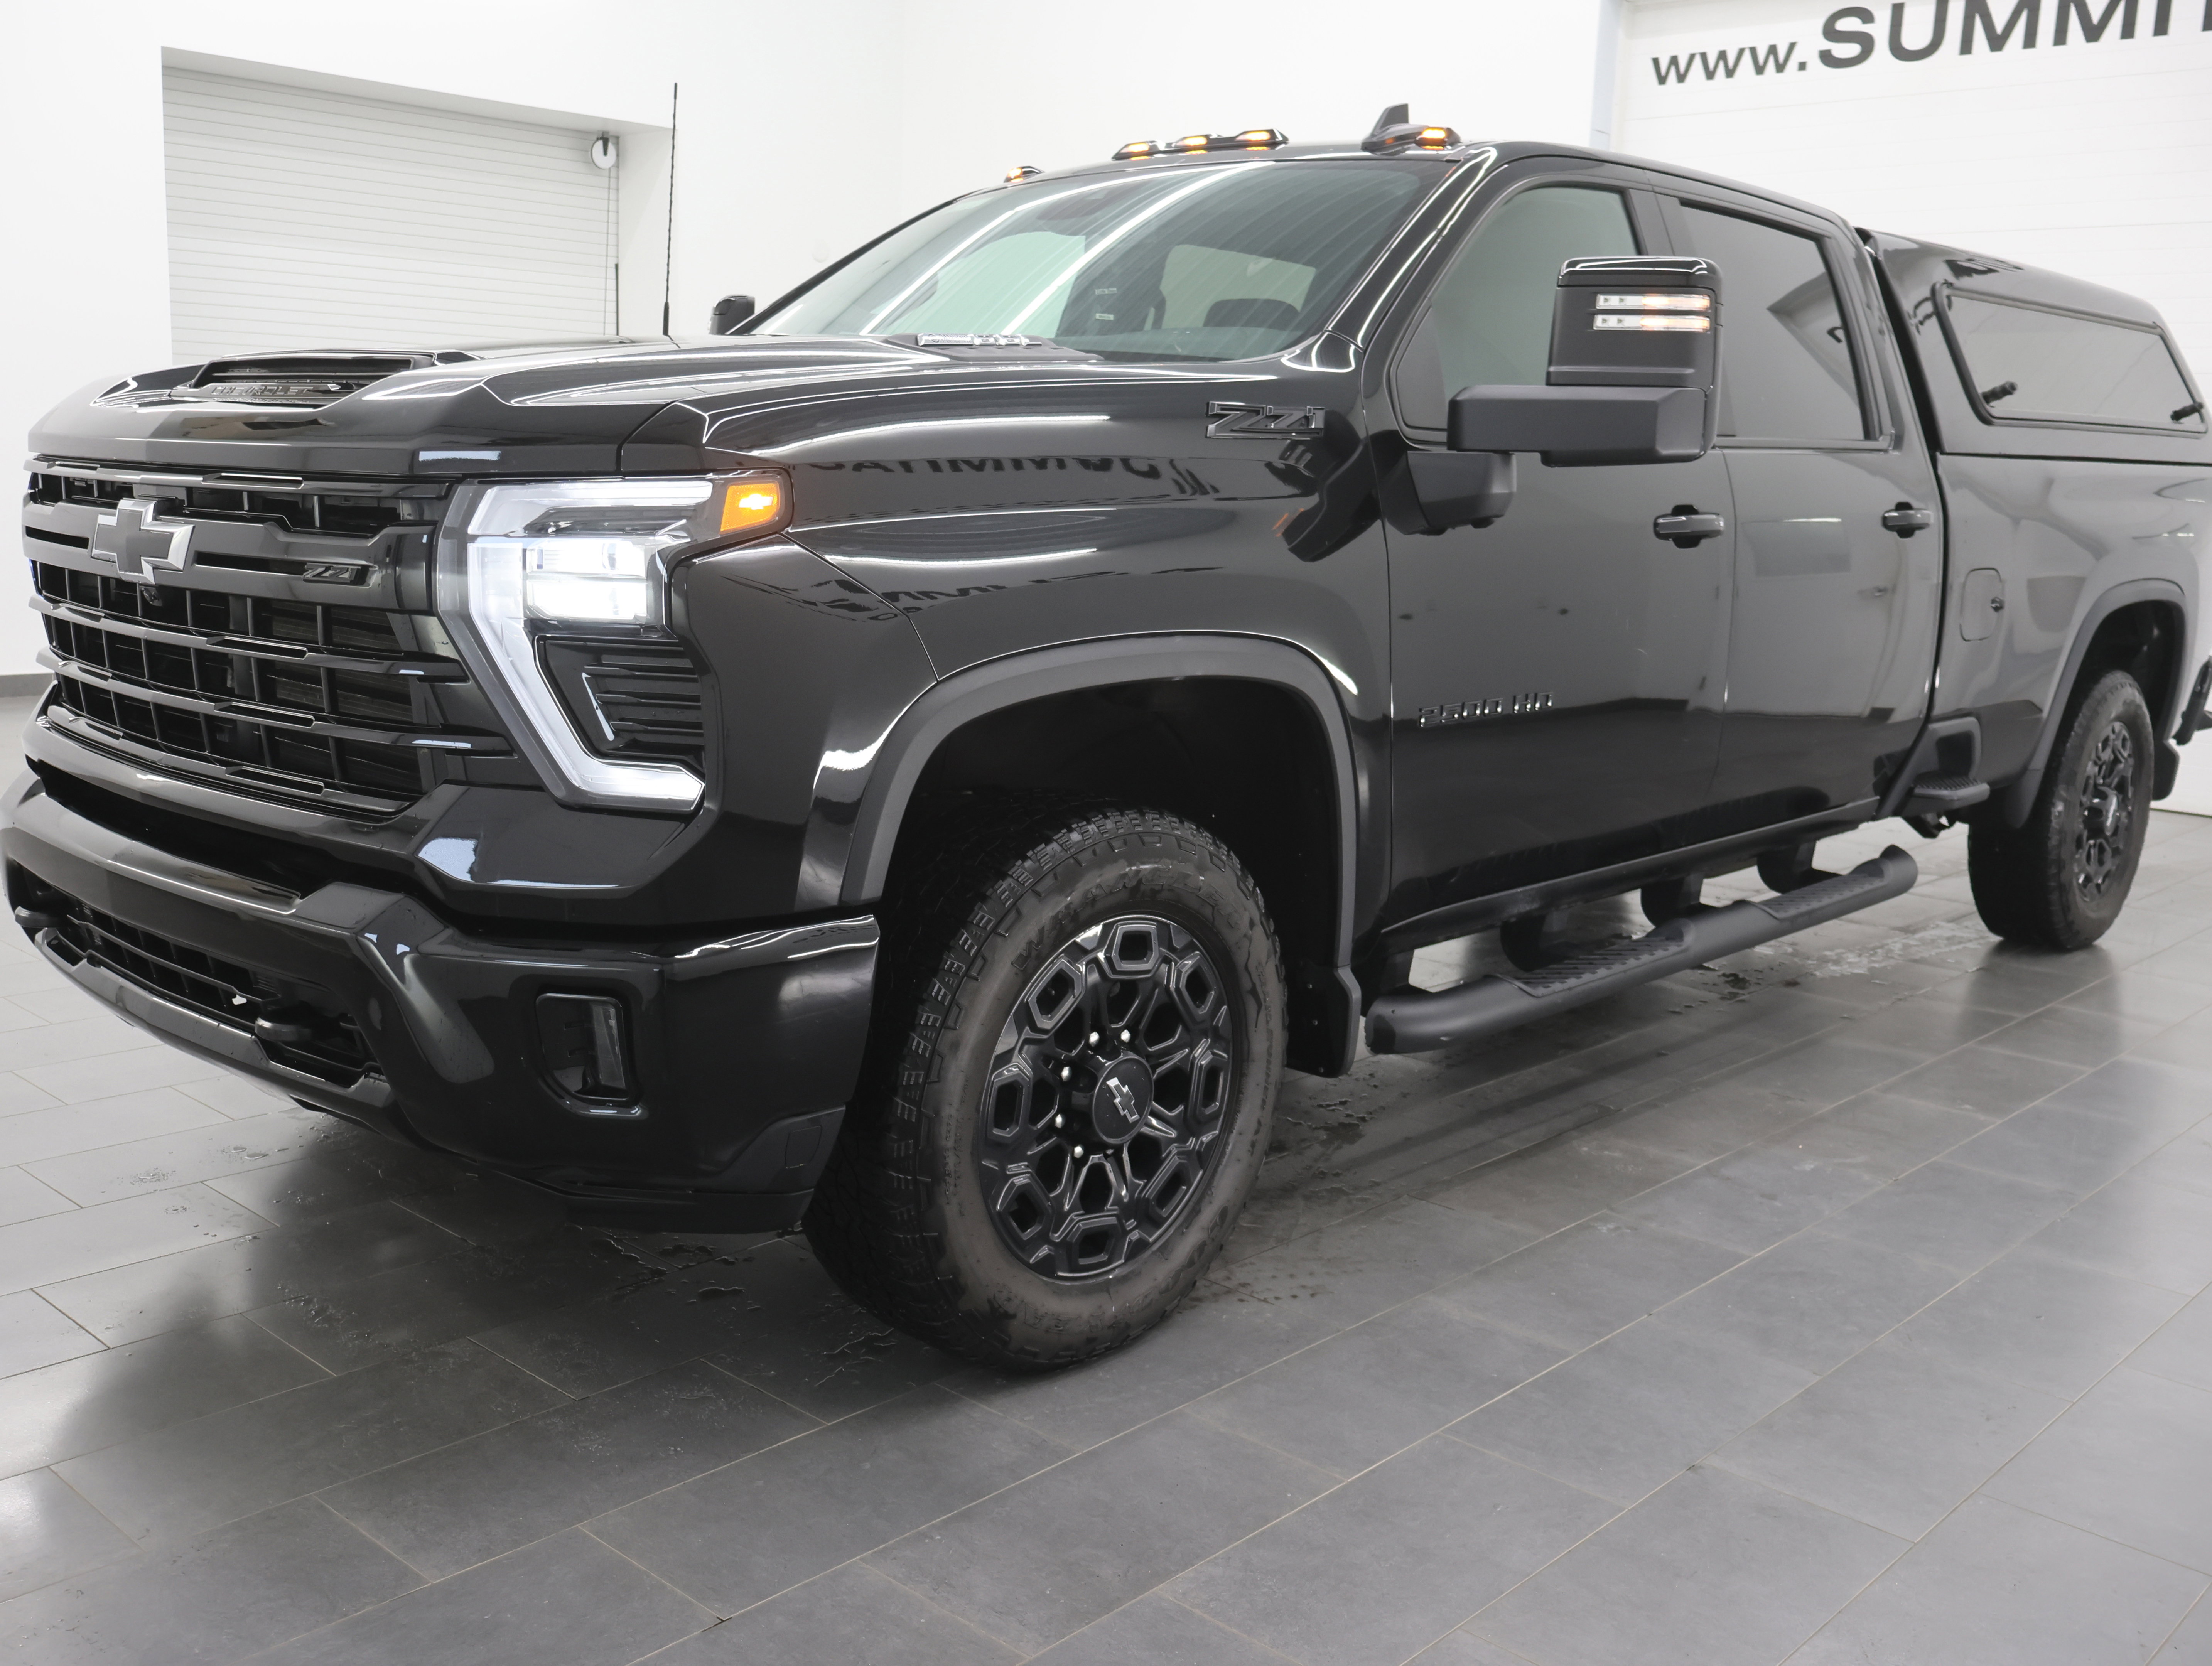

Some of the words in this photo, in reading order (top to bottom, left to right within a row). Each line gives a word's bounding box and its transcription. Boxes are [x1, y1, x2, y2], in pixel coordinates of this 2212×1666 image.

[212, 386, 314, 395] CHEVROLET
[1206, 401, 1325, 440] Z71
[303, 562, 361, 583] Z71
[1418, 698, 1503, 728] 2500
[1513, 692, 1554, 714] HD
